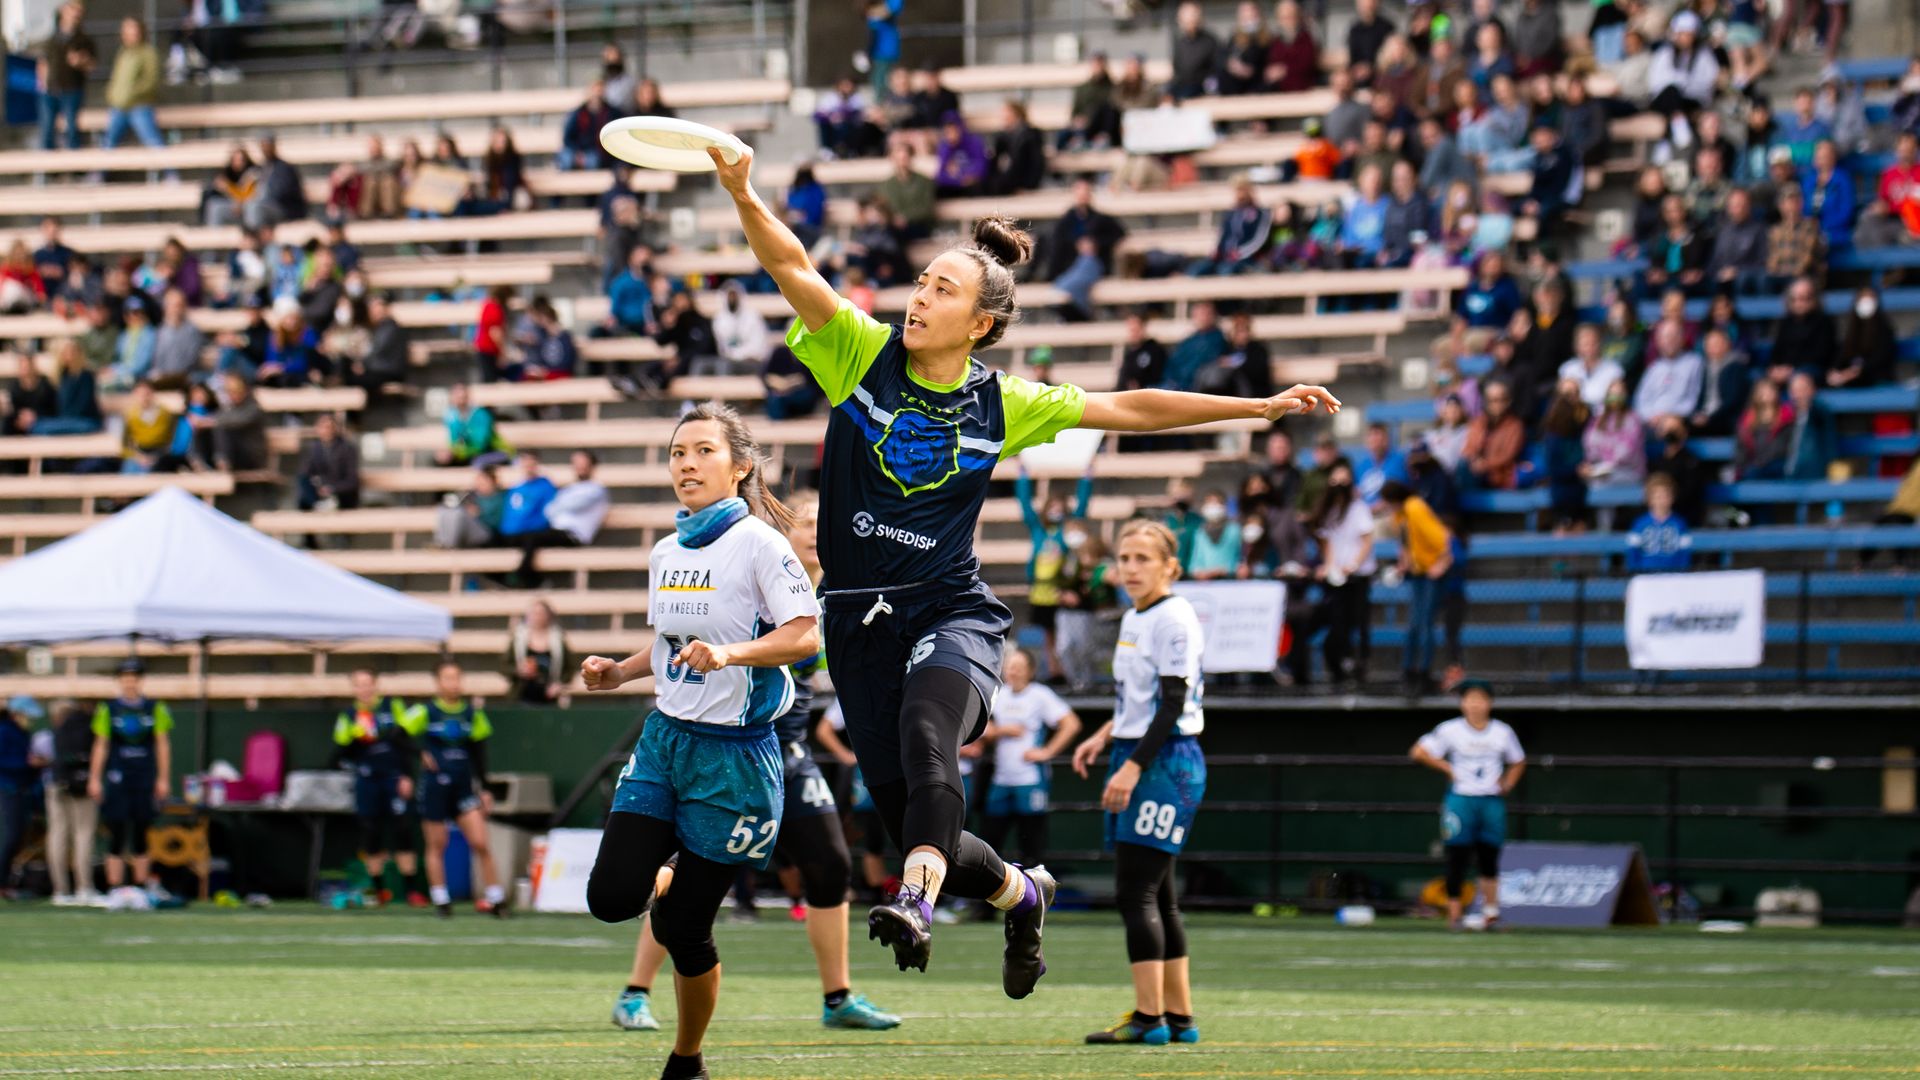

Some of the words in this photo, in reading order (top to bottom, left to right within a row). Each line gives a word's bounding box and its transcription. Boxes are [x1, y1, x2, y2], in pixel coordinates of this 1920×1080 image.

[876, 524, 937, 550] SWEDISH
[660, 569, 711, 589] ASTRA
[669, 602, 709, 615] ANGELES
[1135, 799, 1176, 840] 89
[726, 815, 778, 859] 52
